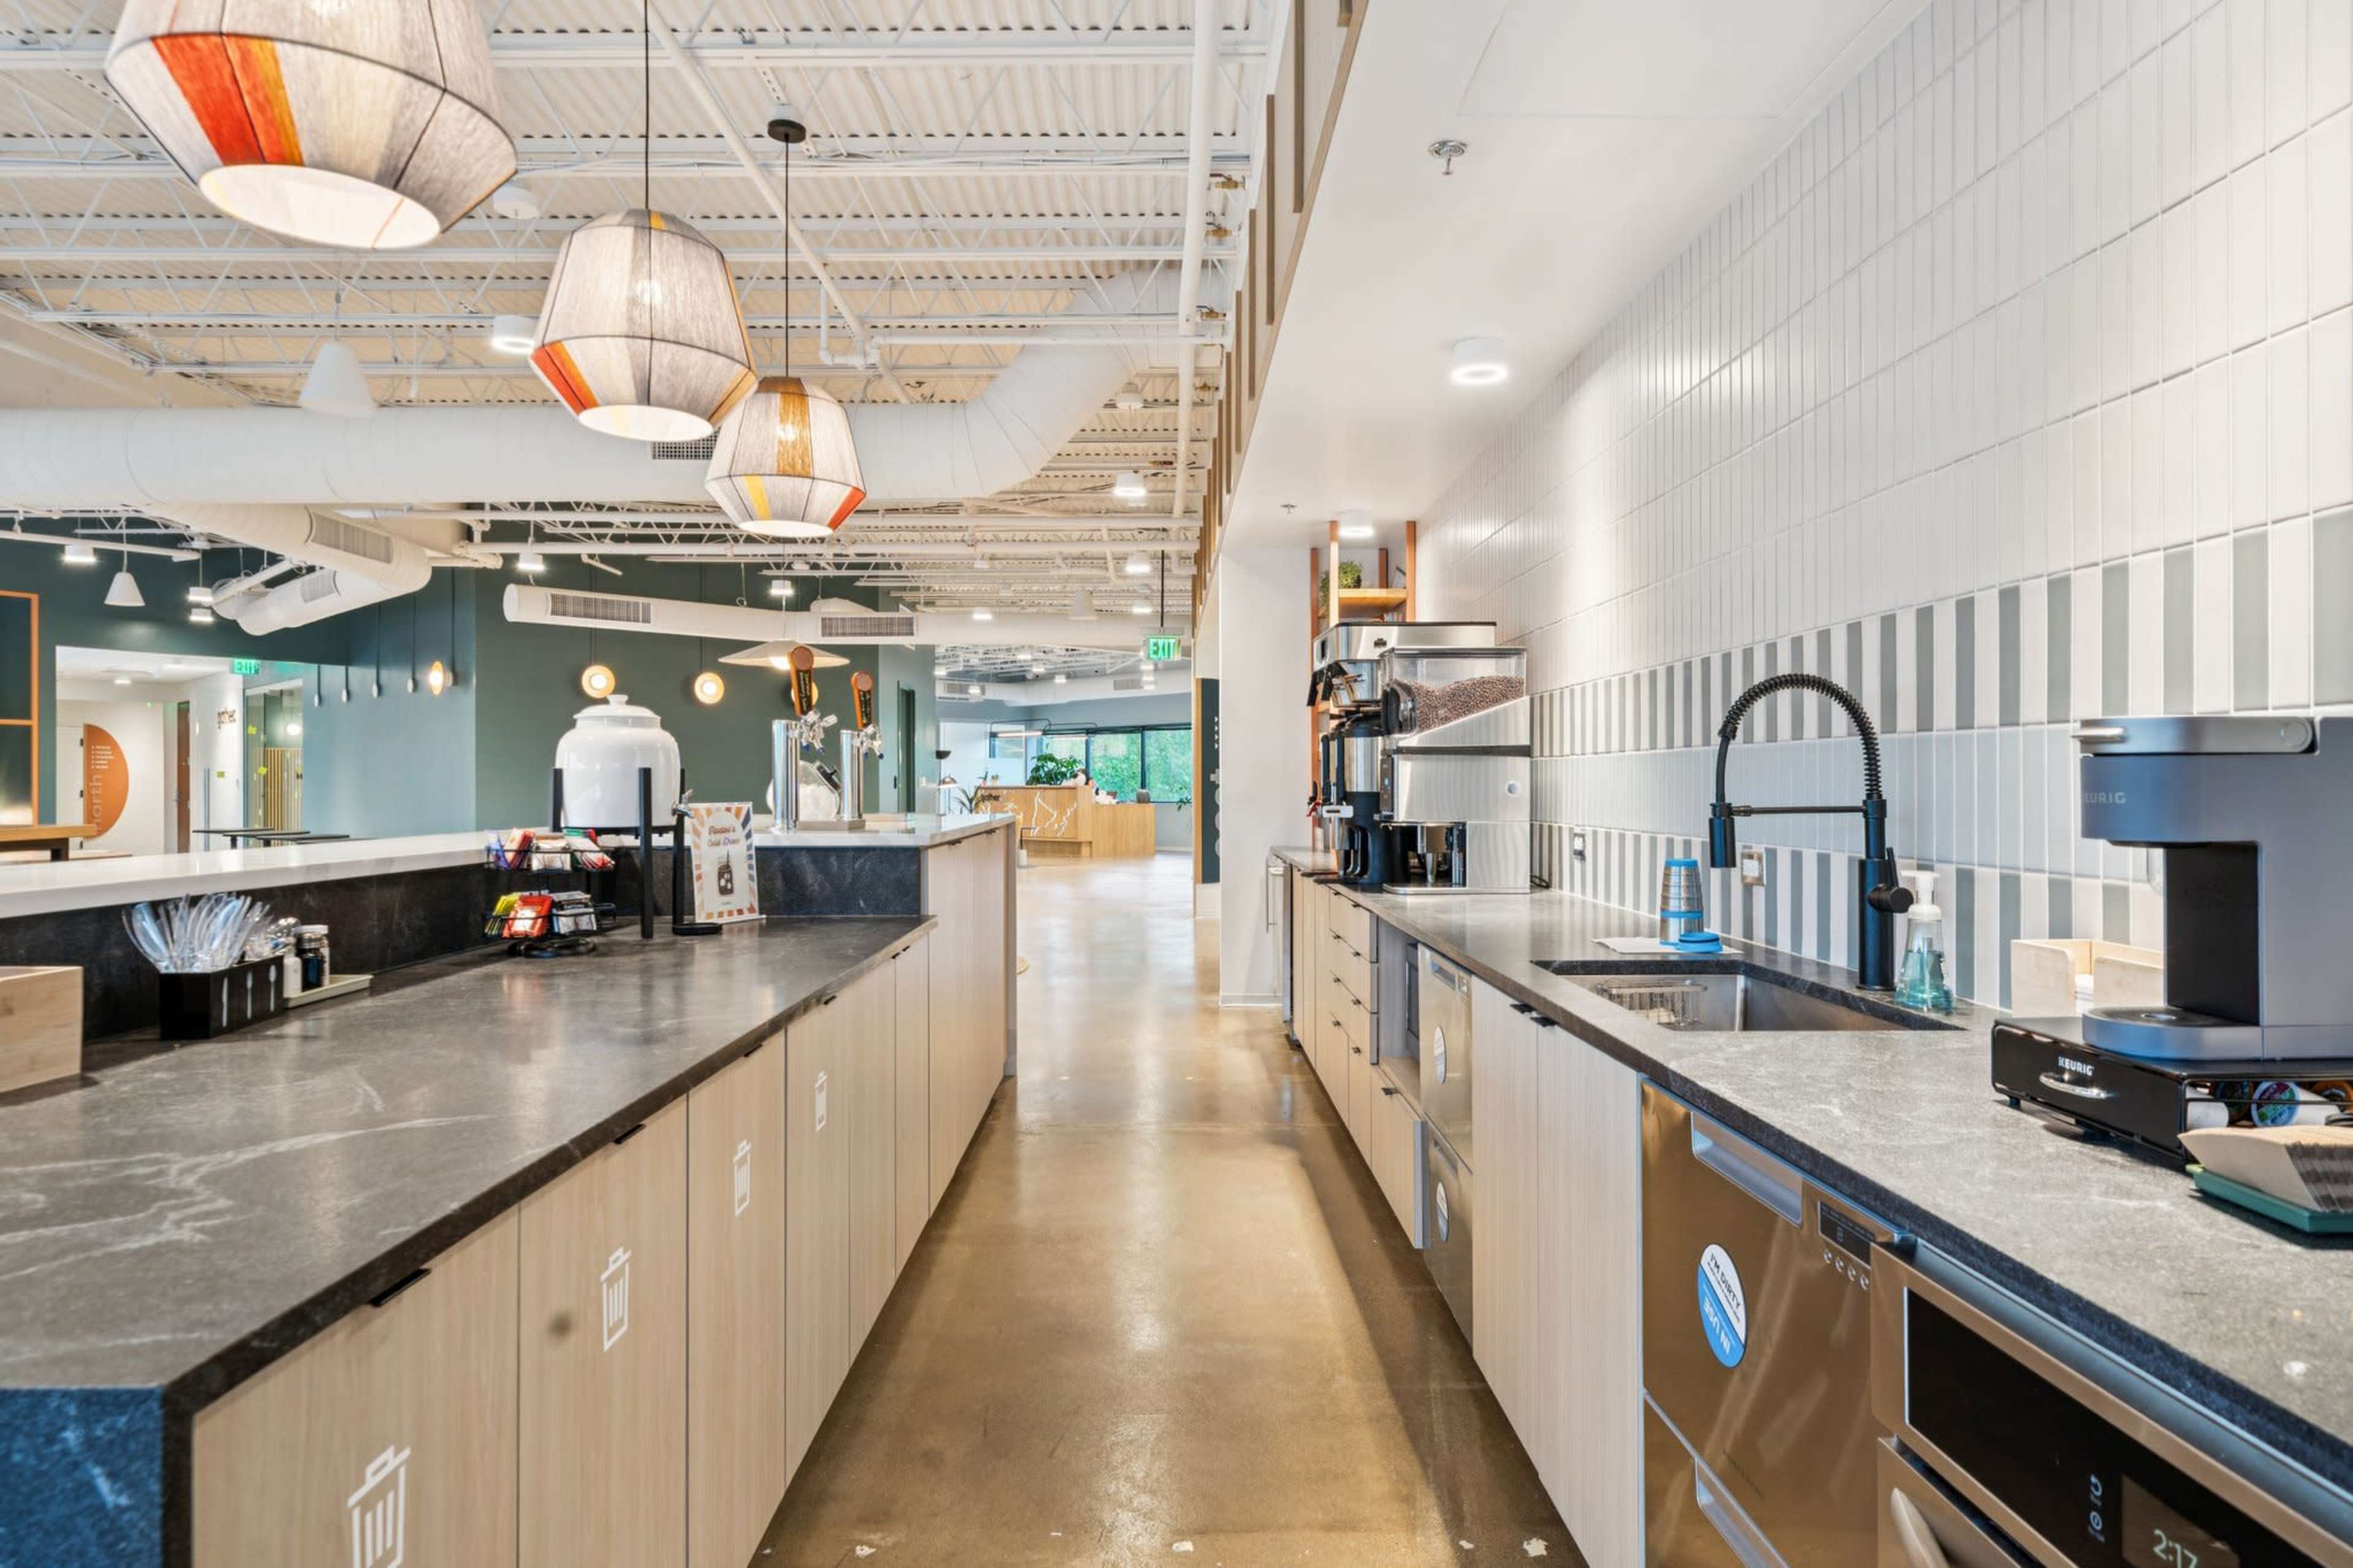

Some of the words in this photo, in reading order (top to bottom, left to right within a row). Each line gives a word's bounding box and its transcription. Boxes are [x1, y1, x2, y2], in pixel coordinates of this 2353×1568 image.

[1150, 638, 1176, 659] EXIT
[2058, 1056, 2093, 1076] KEURIG
[1721, 1271, 1741, 1309] DIRTY
[1703, 1297, 1721, 1333] USE
